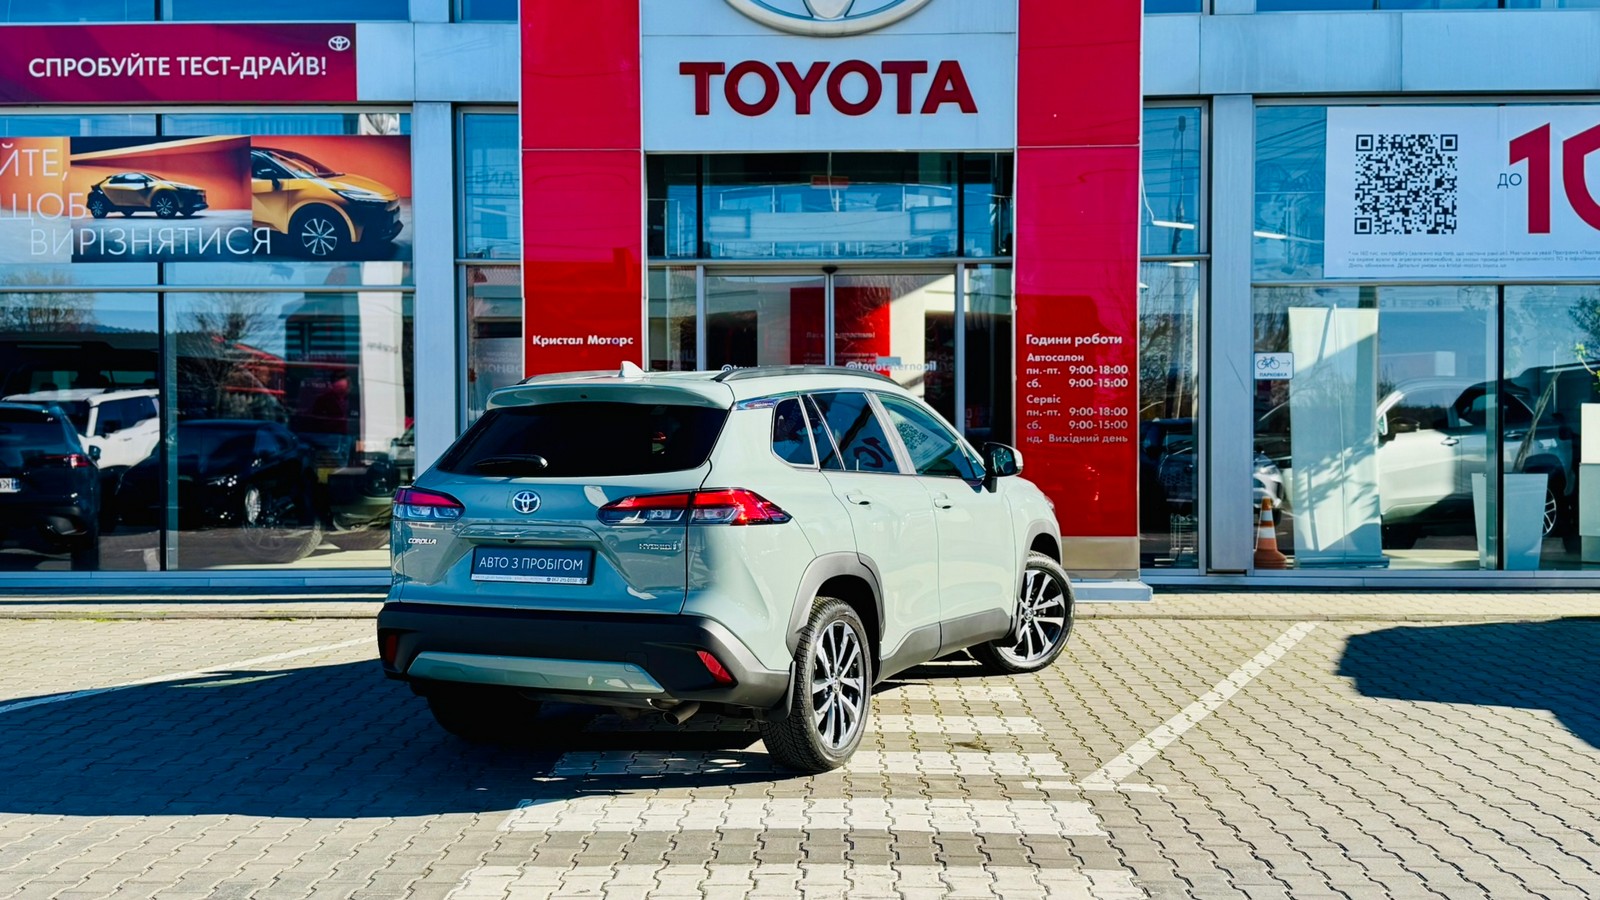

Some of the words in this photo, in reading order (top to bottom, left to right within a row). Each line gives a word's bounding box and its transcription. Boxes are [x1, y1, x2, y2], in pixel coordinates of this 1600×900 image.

[28, 52, 171, 78] СПРОБУЙТЕ
[176, 51, 327, 80] ТЕСТ-ДРАЙВ!
[679, 59, 979, 117] TOYOTA
[1497, 172, 1523, 189] ДО
[30, 226, 271, 256] ВИРІЗНЯТИСЯ
[532, 334, 584, 347] Кристал
[587, 334, 634, 347] Моторс
[1025, 334, 1071, 346] Години
[1075, 332, 1123, 347] роботи
[1026, 353, 1084, 362] Автосалон
[1068, 365, 1128, 375] 9:00-18:00
[1026, 378, 1042, 388] сб.
[1068, 378, 1128, 388] 9:00-15:00
[1026, 394, 1061, 406] Сервіс
[1026, 409, 1061, 417] пн.-пт.
[1068, 407, 1128, 416] 9:00-18:00
[1026, 420, 1042, 430] сб.
[1068, 420, 1128, 430] 9:00-15:00
[1026, 435, 1043, 444] нд.
[1048, 433, 1099, 443] Вихідний
[1102, 435, 1128, 443] день
[407, 537, 437, 545] COROLLA
[478, 556, 509, 569] АВТО
[521, 557, 584, 571] ПРОБІГОМ
